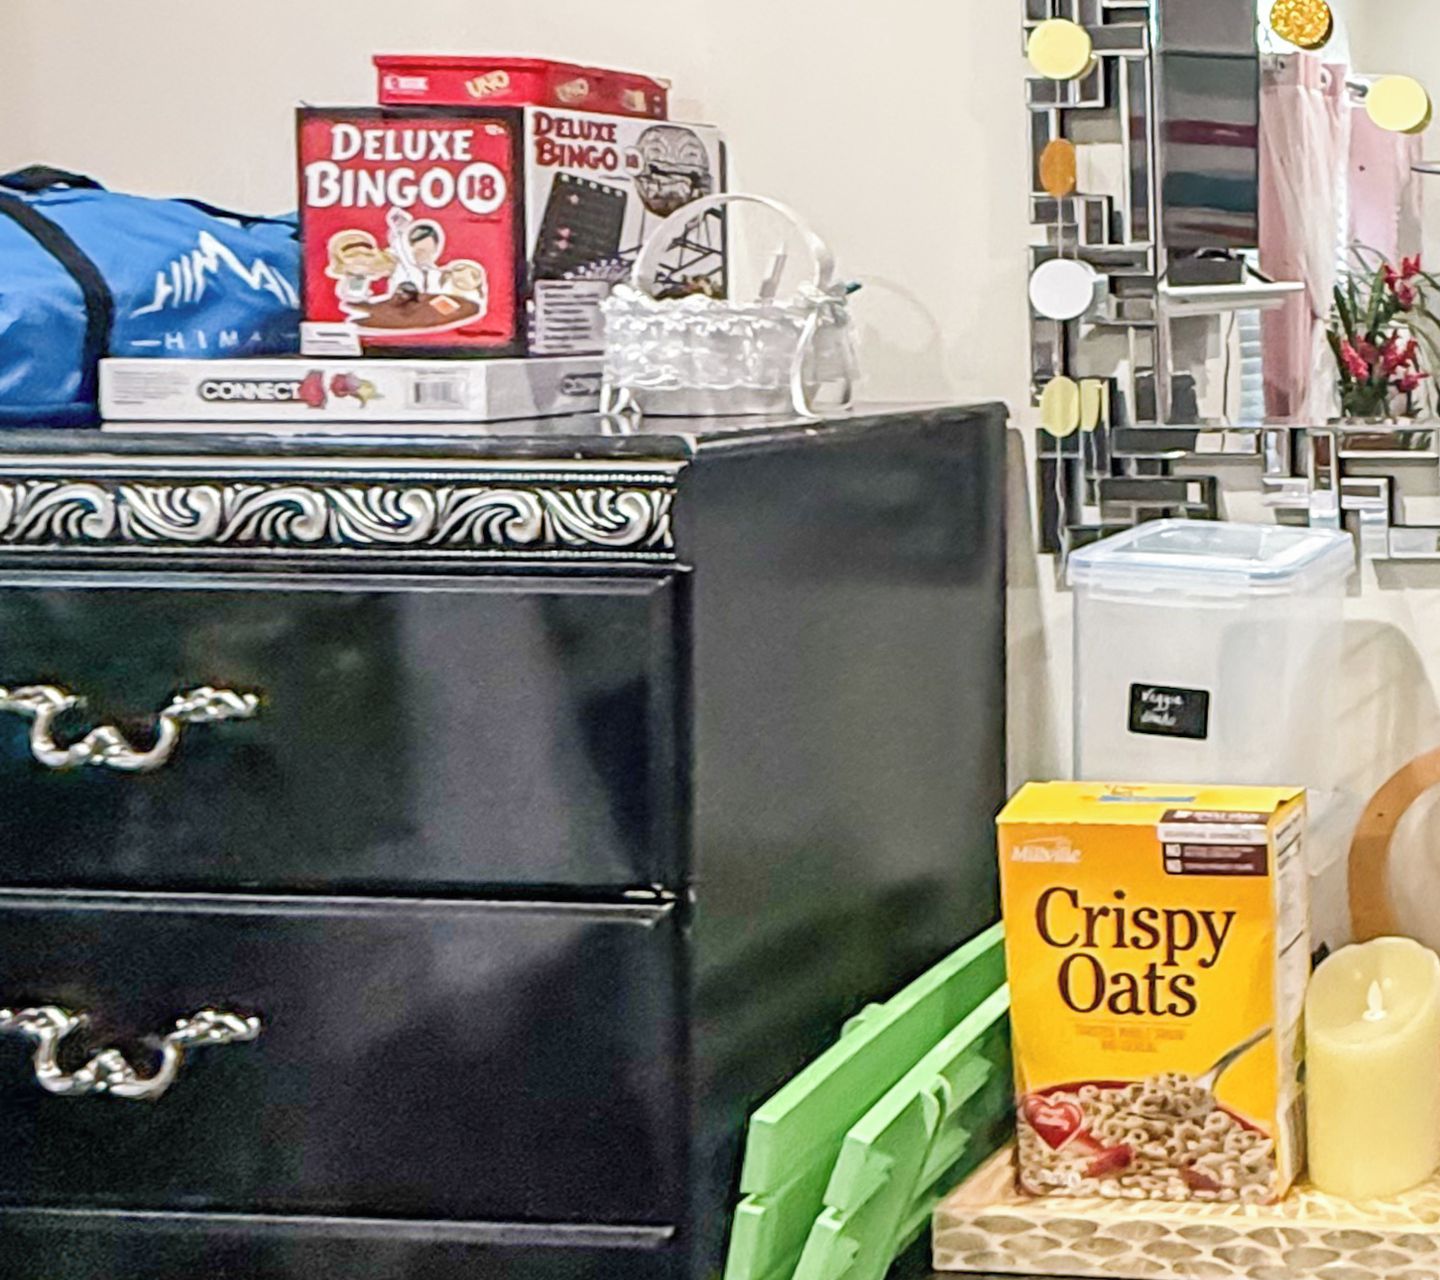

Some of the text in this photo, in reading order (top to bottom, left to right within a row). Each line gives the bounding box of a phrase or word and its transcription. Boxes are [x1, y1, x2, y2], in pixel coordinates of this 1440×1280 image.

[465, 70, 510, 98] UNO
[331, 123, 473, 161] DELUXE
[533, 111, 617, 143] DELUXE
[535, 137, 618, 171] BINGO
[305, 160, 497, 208] BINGO 18
[203, 381, 301, 401] CONNECT
[1035, 886, 1237, 969] Crispy
[1057, 952, 1198, 1017] Oats
